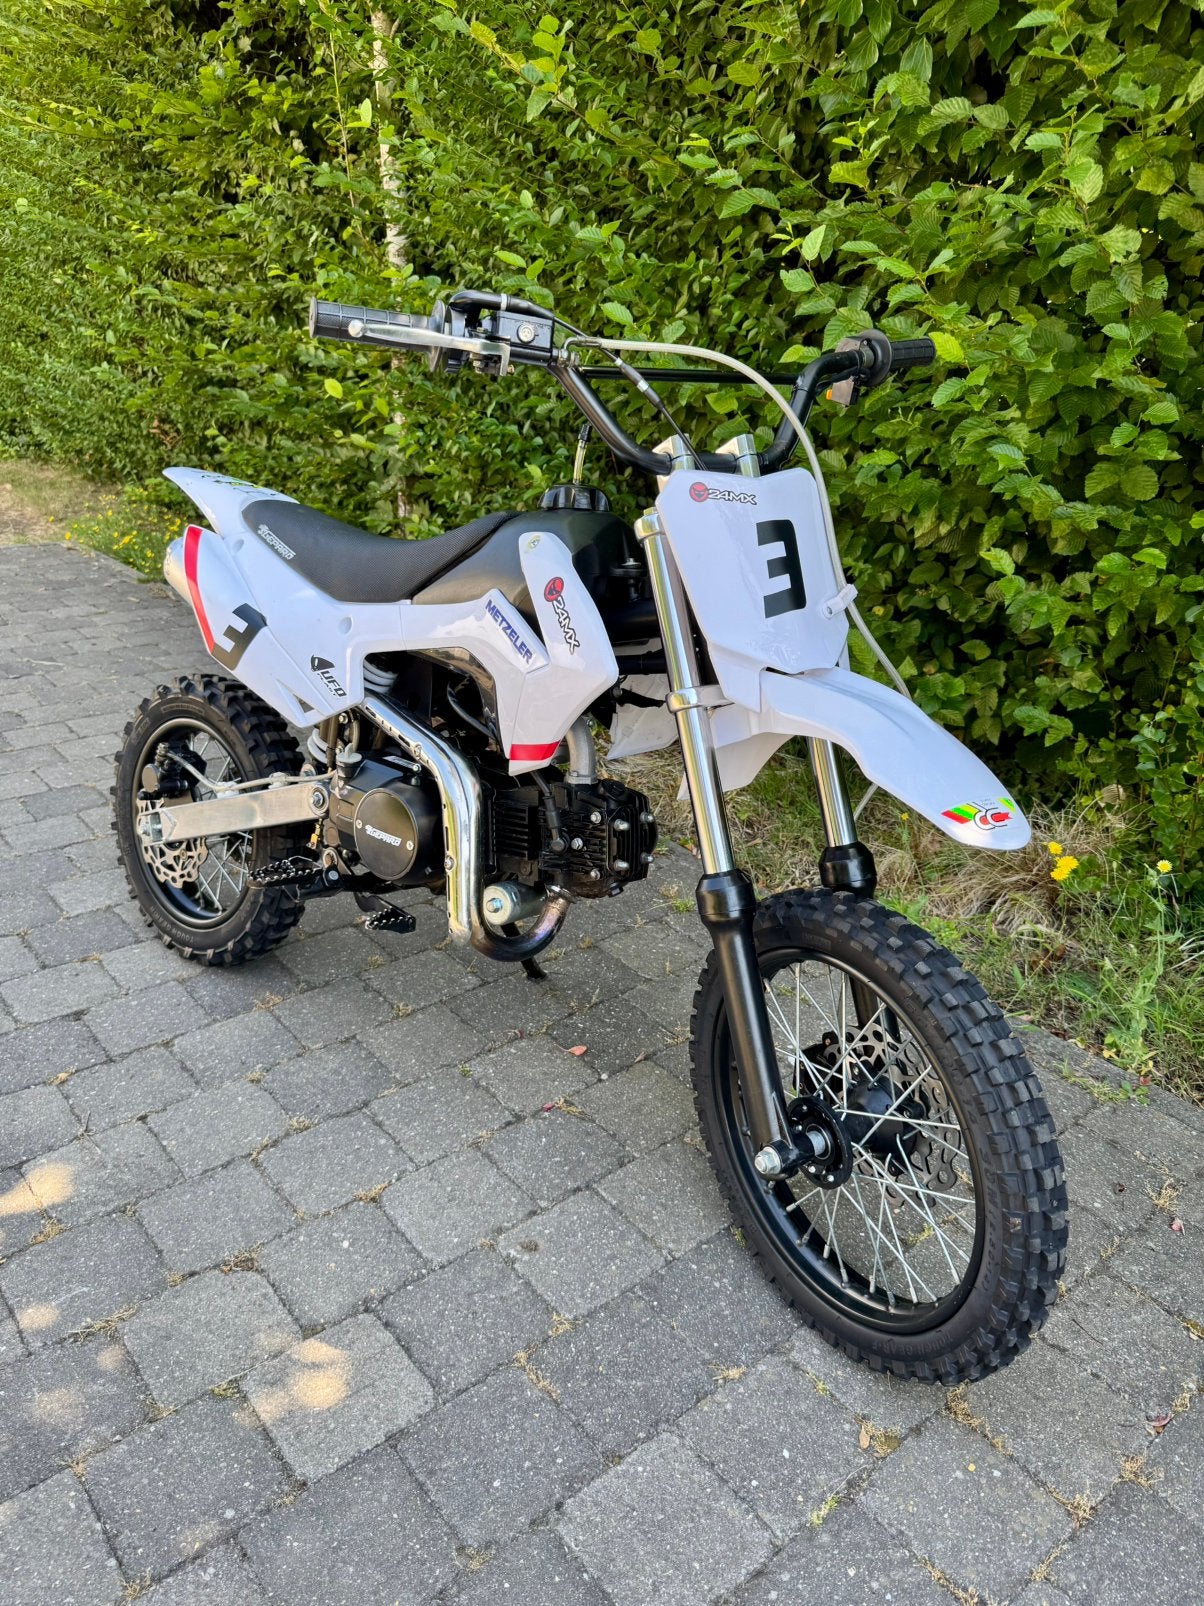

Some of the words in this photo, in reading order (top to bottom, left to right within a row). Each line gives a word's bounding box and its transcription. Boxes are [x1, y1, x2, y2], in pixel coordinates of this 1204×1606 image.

[707, 488, 757, 505] 24MX
[756, 519, 807, 619] 3
[211, 602, 269, 671] 3
[485, 599, 533, 665] METZELER
[551, 595, 580, 656] 24MX
[320, 670, 347, 698] UFO
